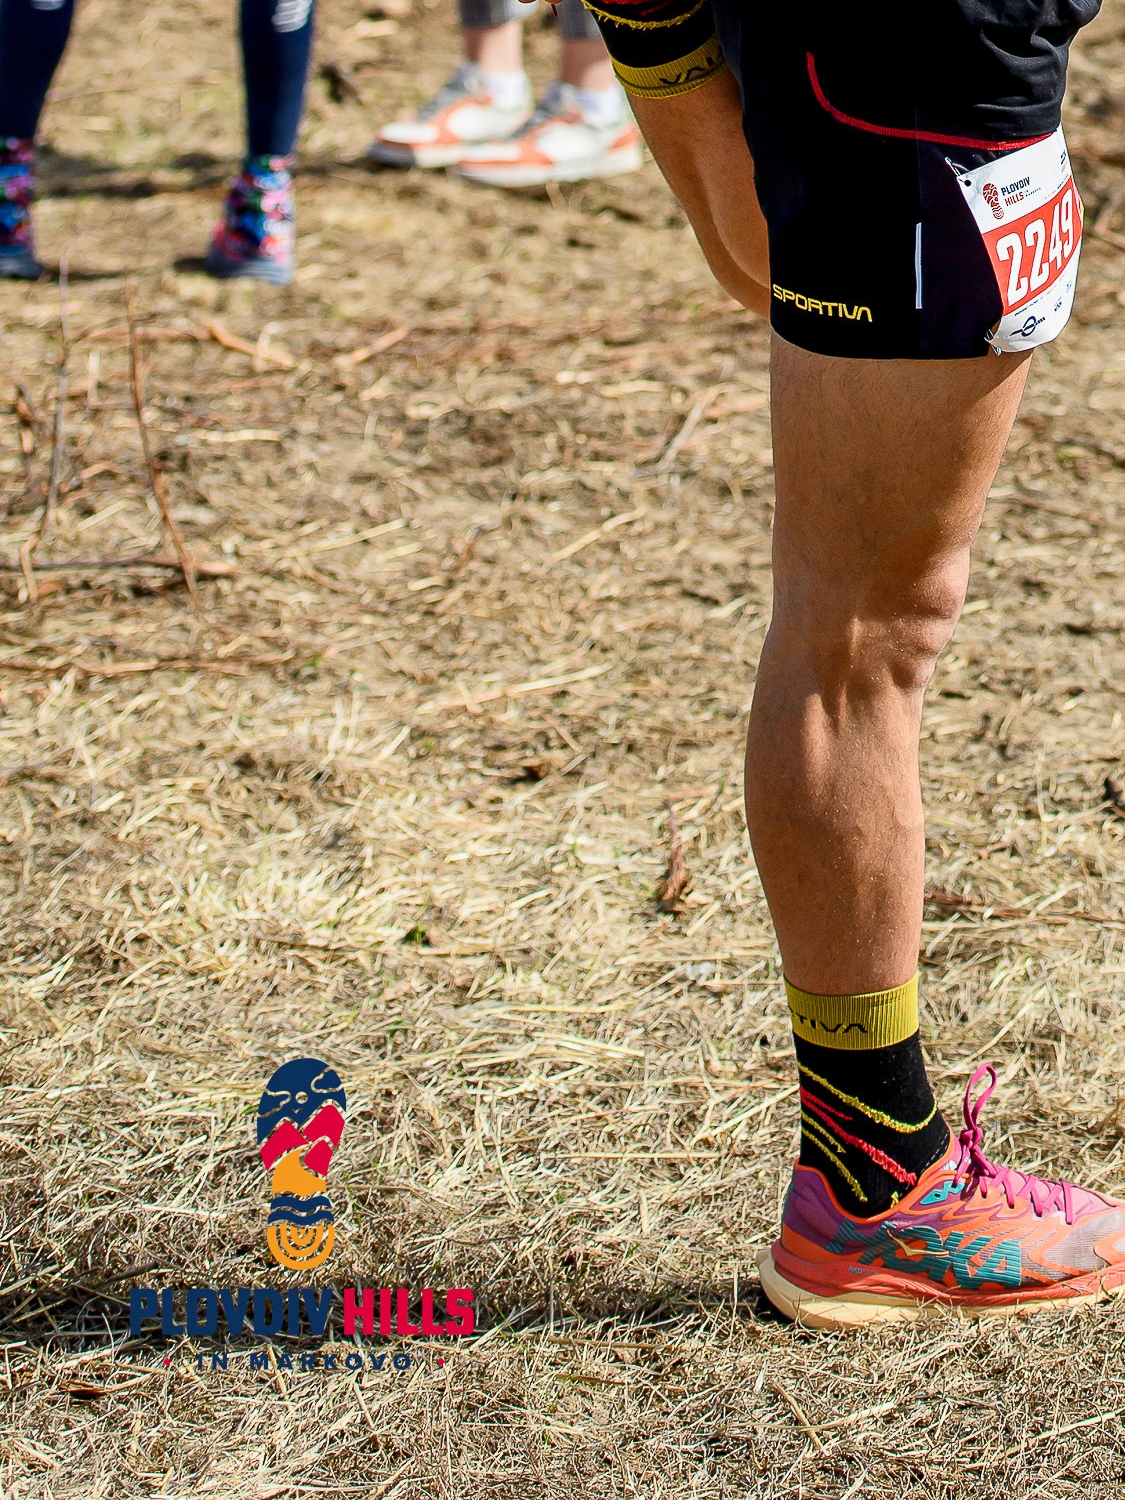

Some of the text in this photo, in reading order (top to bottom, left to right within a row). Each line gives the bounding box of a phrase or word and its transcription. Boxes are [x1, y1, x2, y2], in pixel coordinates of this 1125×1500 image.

[1000, 176, 1031, 196] PLOVDIV
[1004, 191, 1025, 207] HILLS
[995, 188, 1075, 308] 2249
[772, 283, 873, 323] SPORTIVA
[787, 1005, 868, 1034] TIVA
